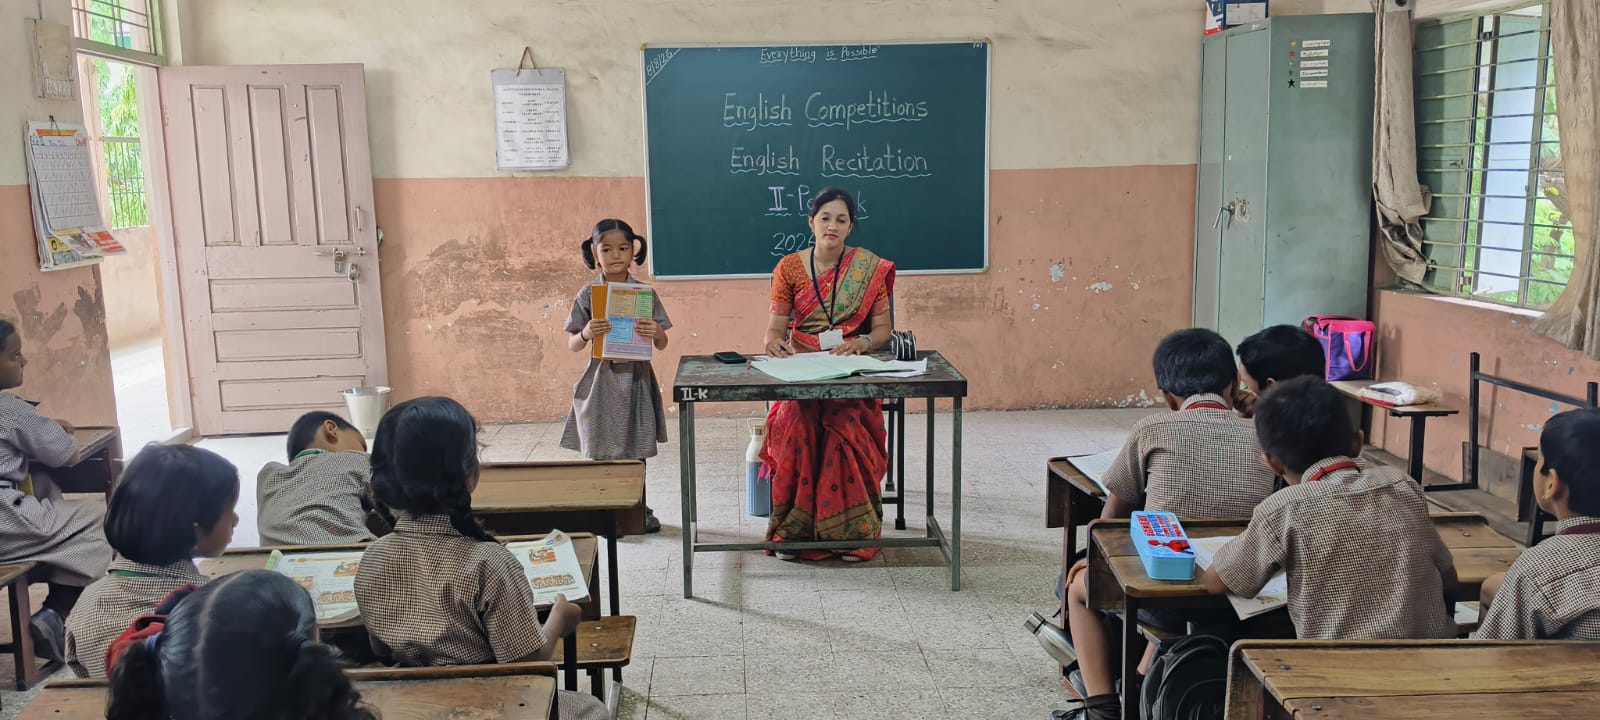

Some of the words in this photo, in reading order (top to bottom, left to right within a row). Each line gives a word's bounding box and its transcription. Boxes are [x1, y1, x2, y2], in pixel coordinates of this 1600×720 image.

[646, 48, 673, 77] 8/8/26
[760, 47, 816, 63] Everything
[826, 48, 835, 57] is
[841, 45, 878, 58] Possible
[723, 92, 792, 132] English
[804, 89, 929, 131] Competitions
[730, 143, 799, 176] English
[822, 143, 928, 172] Recitation
[680, 387, 708, 401] II-K
